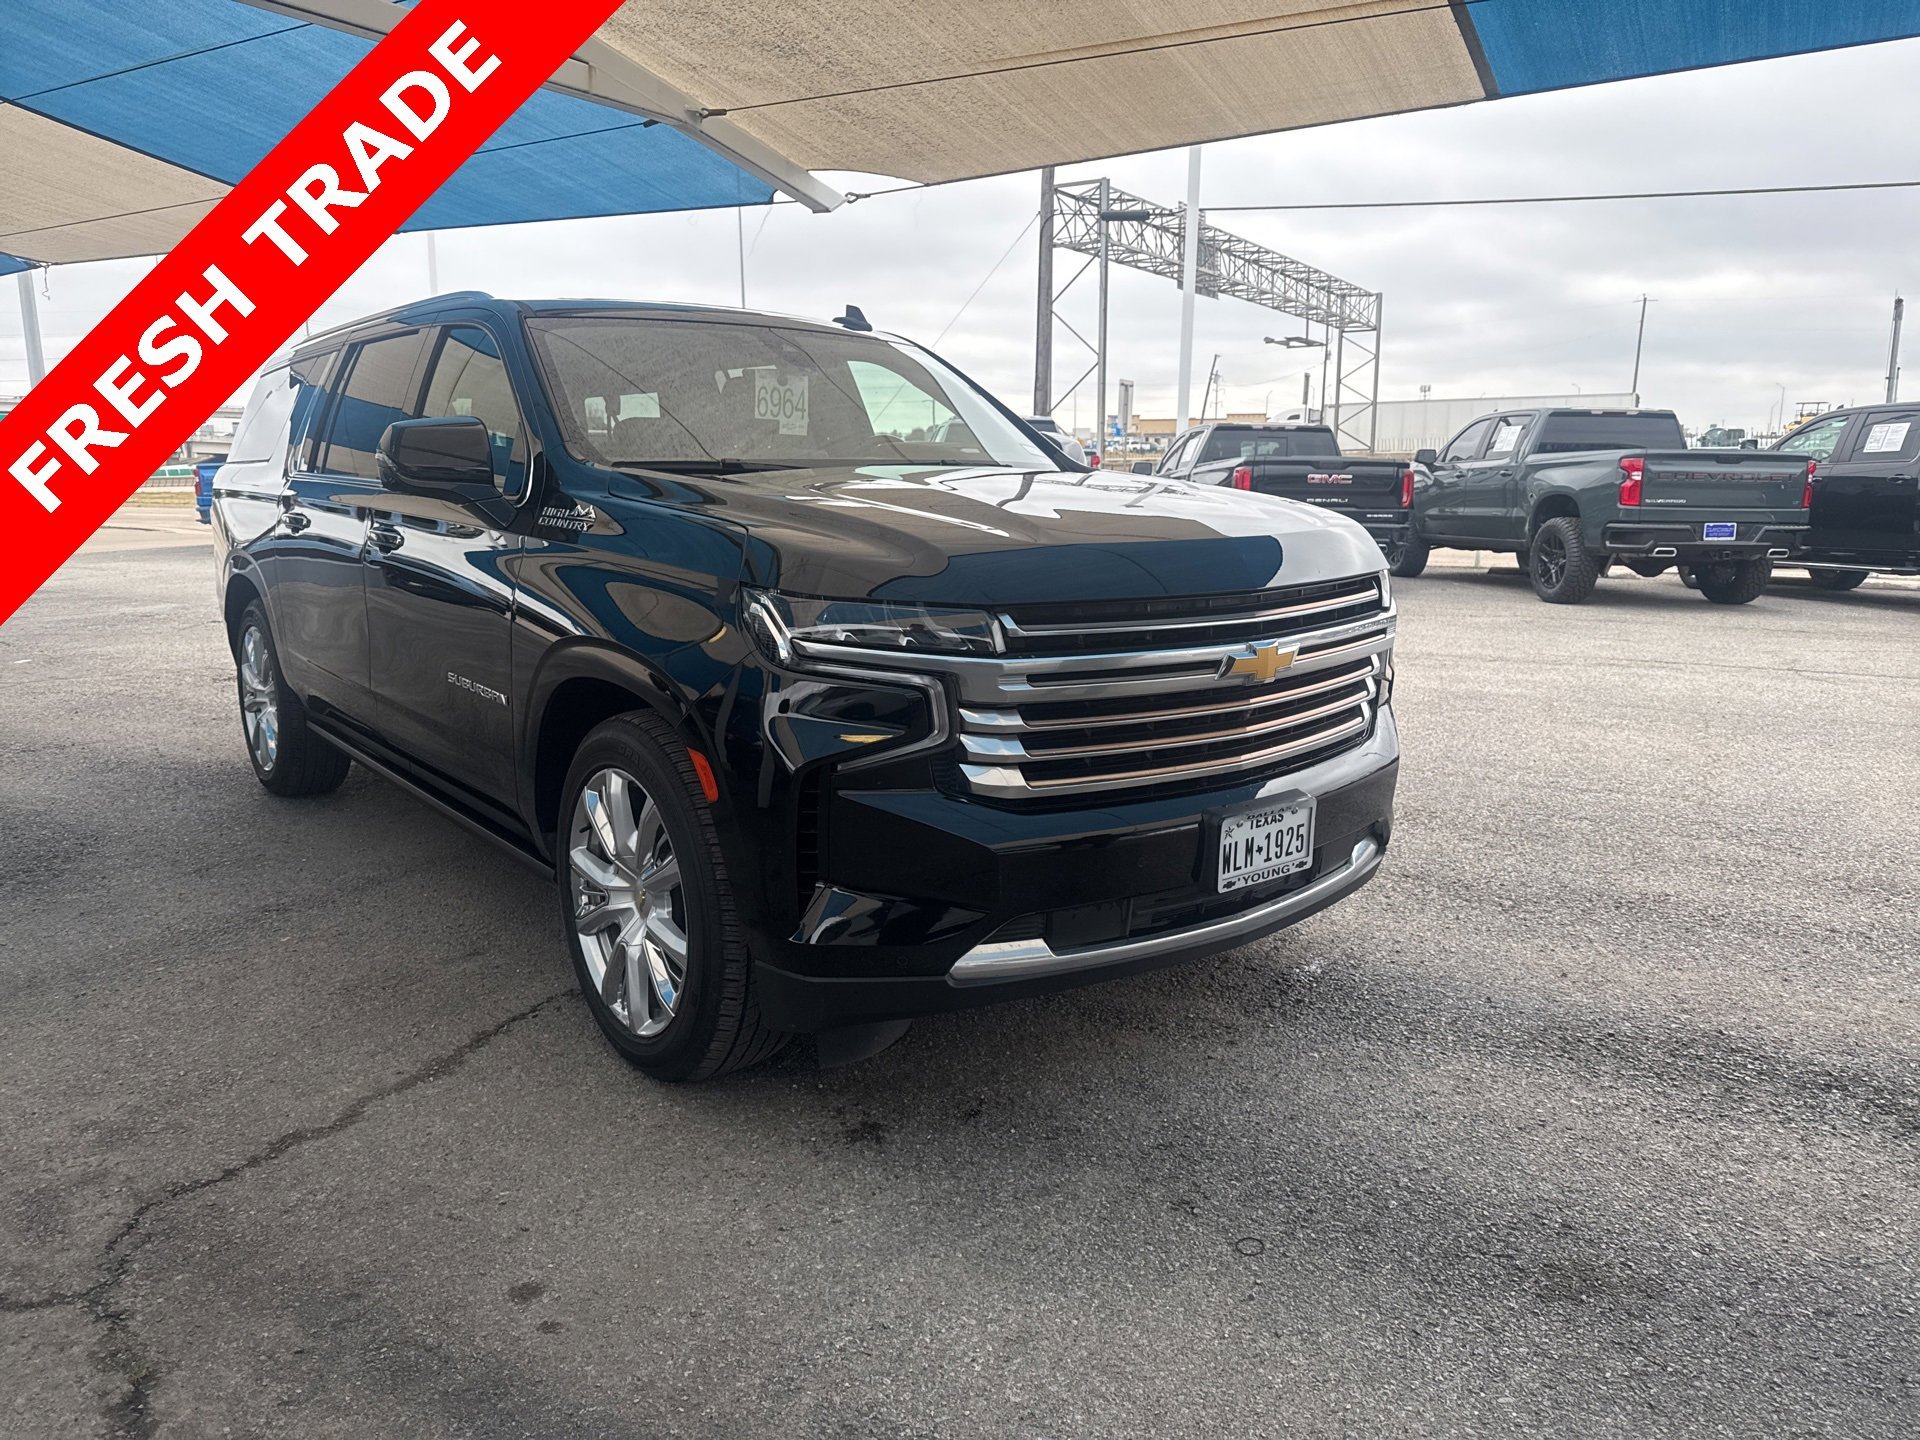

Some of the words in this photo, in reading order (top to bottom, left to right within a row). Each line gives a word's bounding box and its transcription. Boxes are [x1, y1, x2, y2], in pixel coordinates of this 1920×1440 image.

[757, 386, 807, 420] 6964
[1307, 473, 1353, 484] GMC
[1657, 472, 1798, 482] CHEVROLET
[542, 506, 570, 518] HIGH
[538, 516, 594, 532] COUNTRY
[447, 672, 509, 706] SUBURBAN
[1250, 813, 1284, 830] TEXAS
[1222, 837, 1255, 875] WLM
[1263, 823, 1305, 863] 1925
